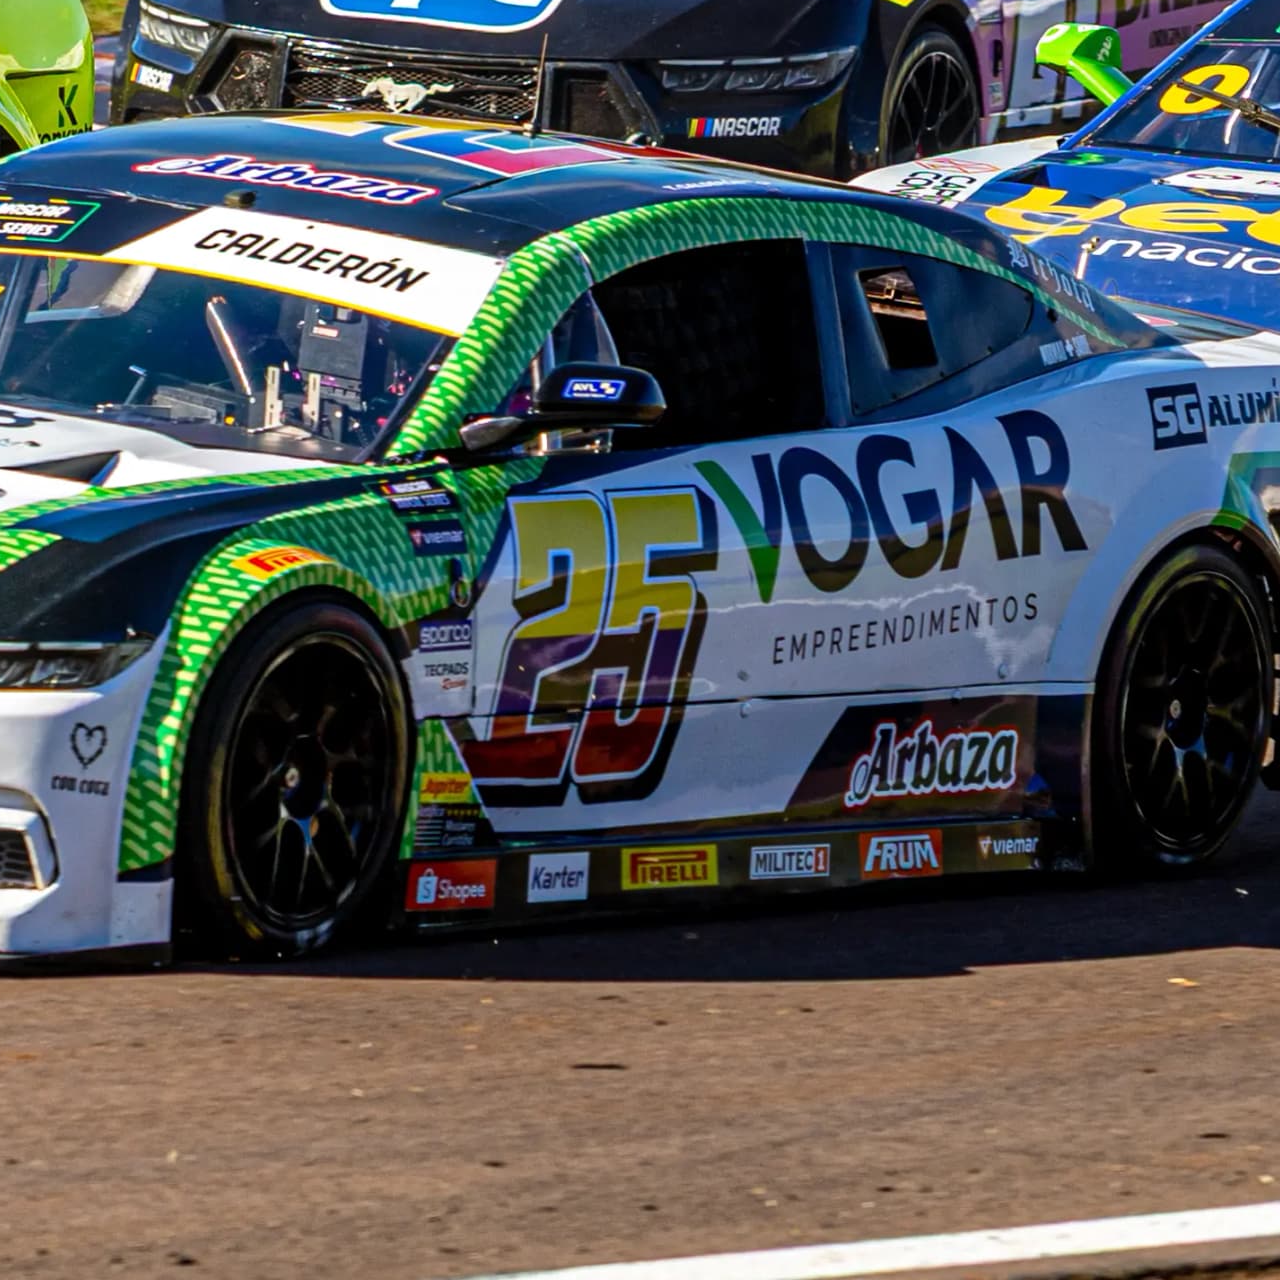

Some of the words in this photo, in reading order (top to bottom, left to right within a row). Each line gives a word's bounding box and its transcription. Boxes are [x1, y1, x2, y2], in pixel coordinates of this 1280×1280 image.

[711, 116, 781, 138] NASCAR
[134, 153, 438, 205] Arbaza
[193, 228, 430, 293] CALDERÓN
[1152, 393, 1205, 442] SG
[692, 408, 1089, 604] VOGAR
[420, 623, 471, 645] sparco
[460, 486, 718, 806] 25
[772, 592, 1040, 667] EMPREENDIMENTOS
[424, 663, 470, 678] TECPADS
[845, 720, 1018, 807] Arbaza
[753, 850, 815, 874] MILITEC
[864, 833, 940, 873] FRUM
[992, 836, 1040, 856] viemar
[530, 866, 586, 891] Karter
[629, 850, 709, 884] PIRELLI
[437, 878, 487, 904] Shopee
